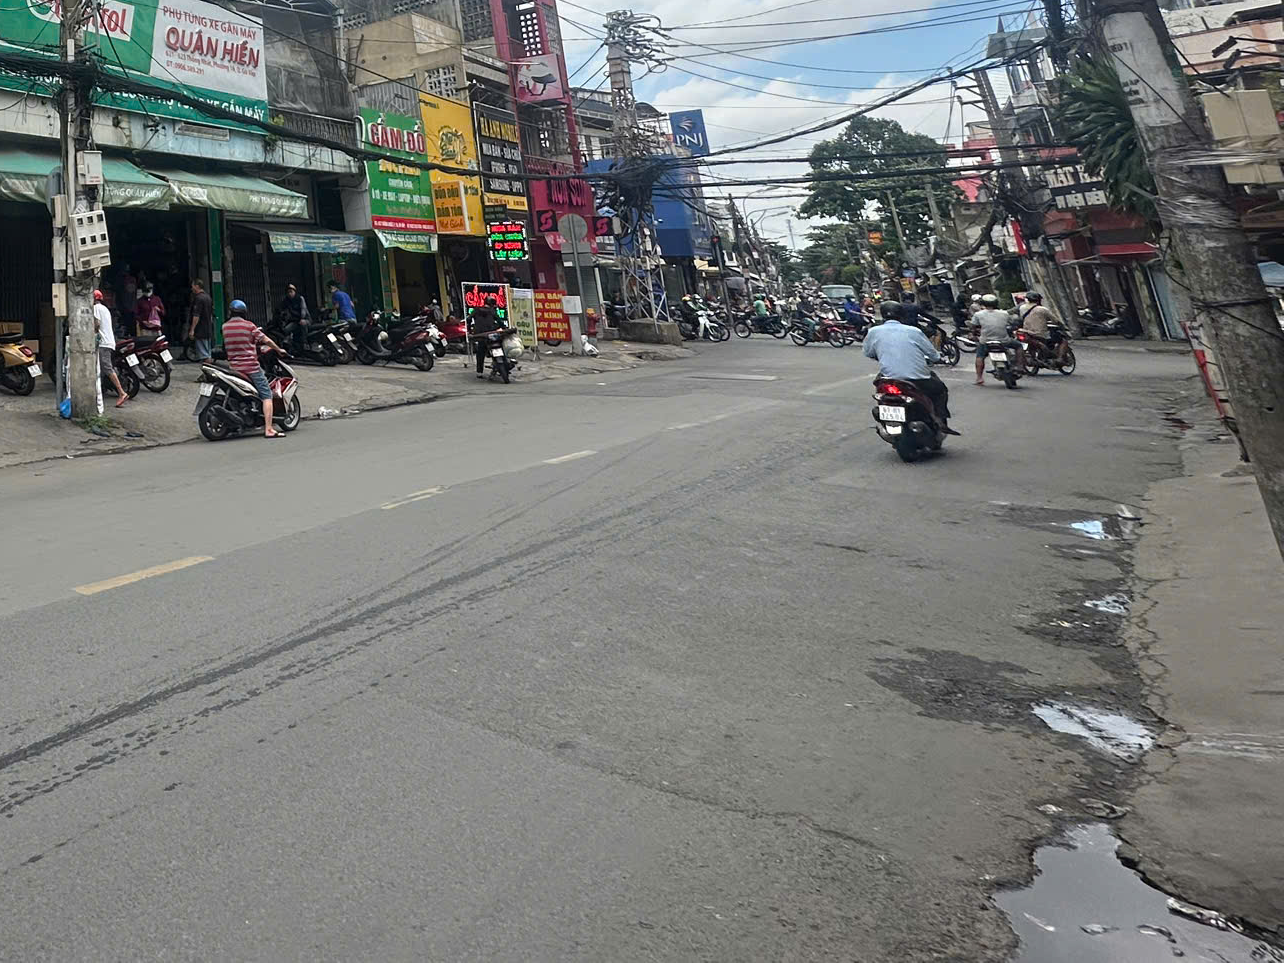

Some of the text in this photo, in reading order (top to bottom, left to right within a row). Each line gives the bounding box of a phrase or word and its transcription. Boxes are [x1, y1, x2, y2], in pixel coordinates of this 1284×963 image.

[162, 5, 182, 23] PHỤ
[208, 18, 219, 31] XE
[165, 26, 219, 59] QUÂN
[676, 132, 703, 148] PNJ
